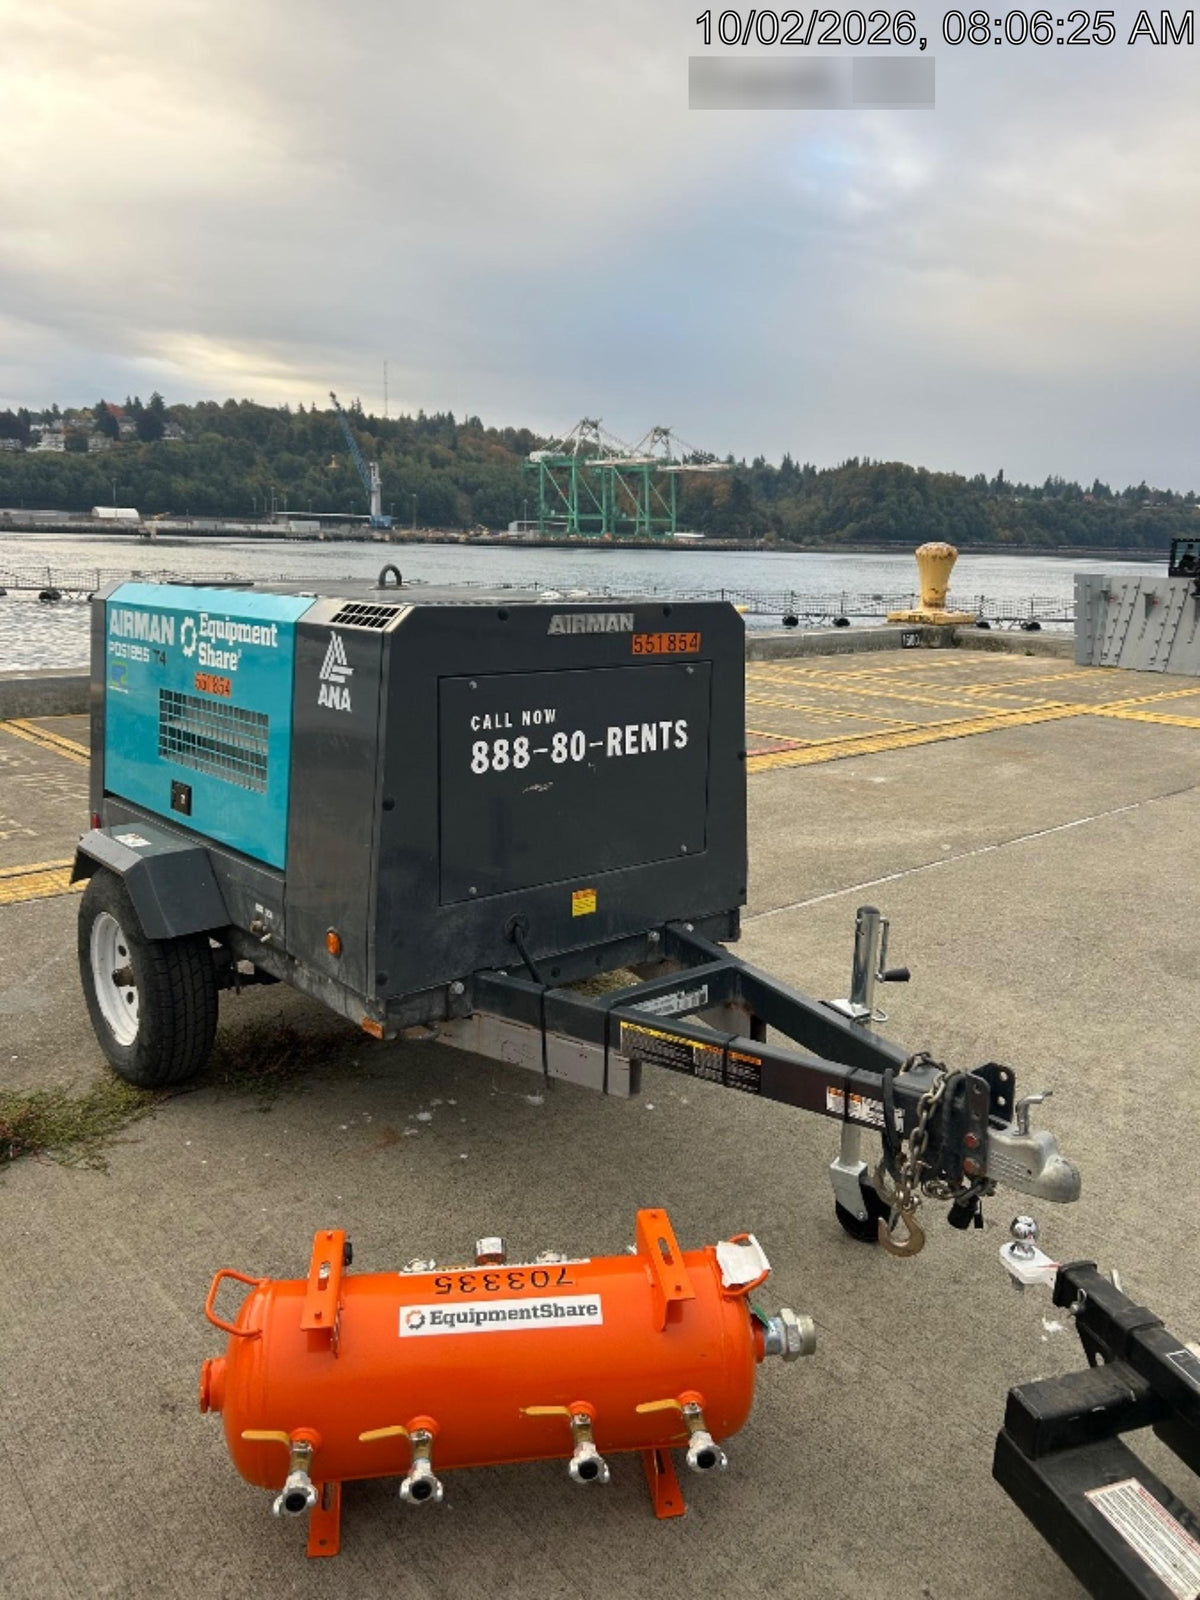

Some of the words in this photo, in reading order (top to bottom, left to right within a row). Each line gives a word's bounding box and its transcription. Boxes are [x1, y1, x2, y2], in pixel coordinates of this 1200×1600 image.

[109, 608, 175, 646] AIRMAN
[199, 612, 278, 647] Equipment
[547, 613, 635, 635] AIRMAN
[198, 642, 239, 672] Share
[633, 633, 700, 654] 551854
[317, 684, 352, 713] ANA
[470, 712, 513, 731] CALL
[521, 708, 557, 727] NOW
[470, 719, 689, 774] 888-80-RENTS
[434, 1267, 573, 1295] 703335
[429, 1302, 599, 1327] EquipmentShare
